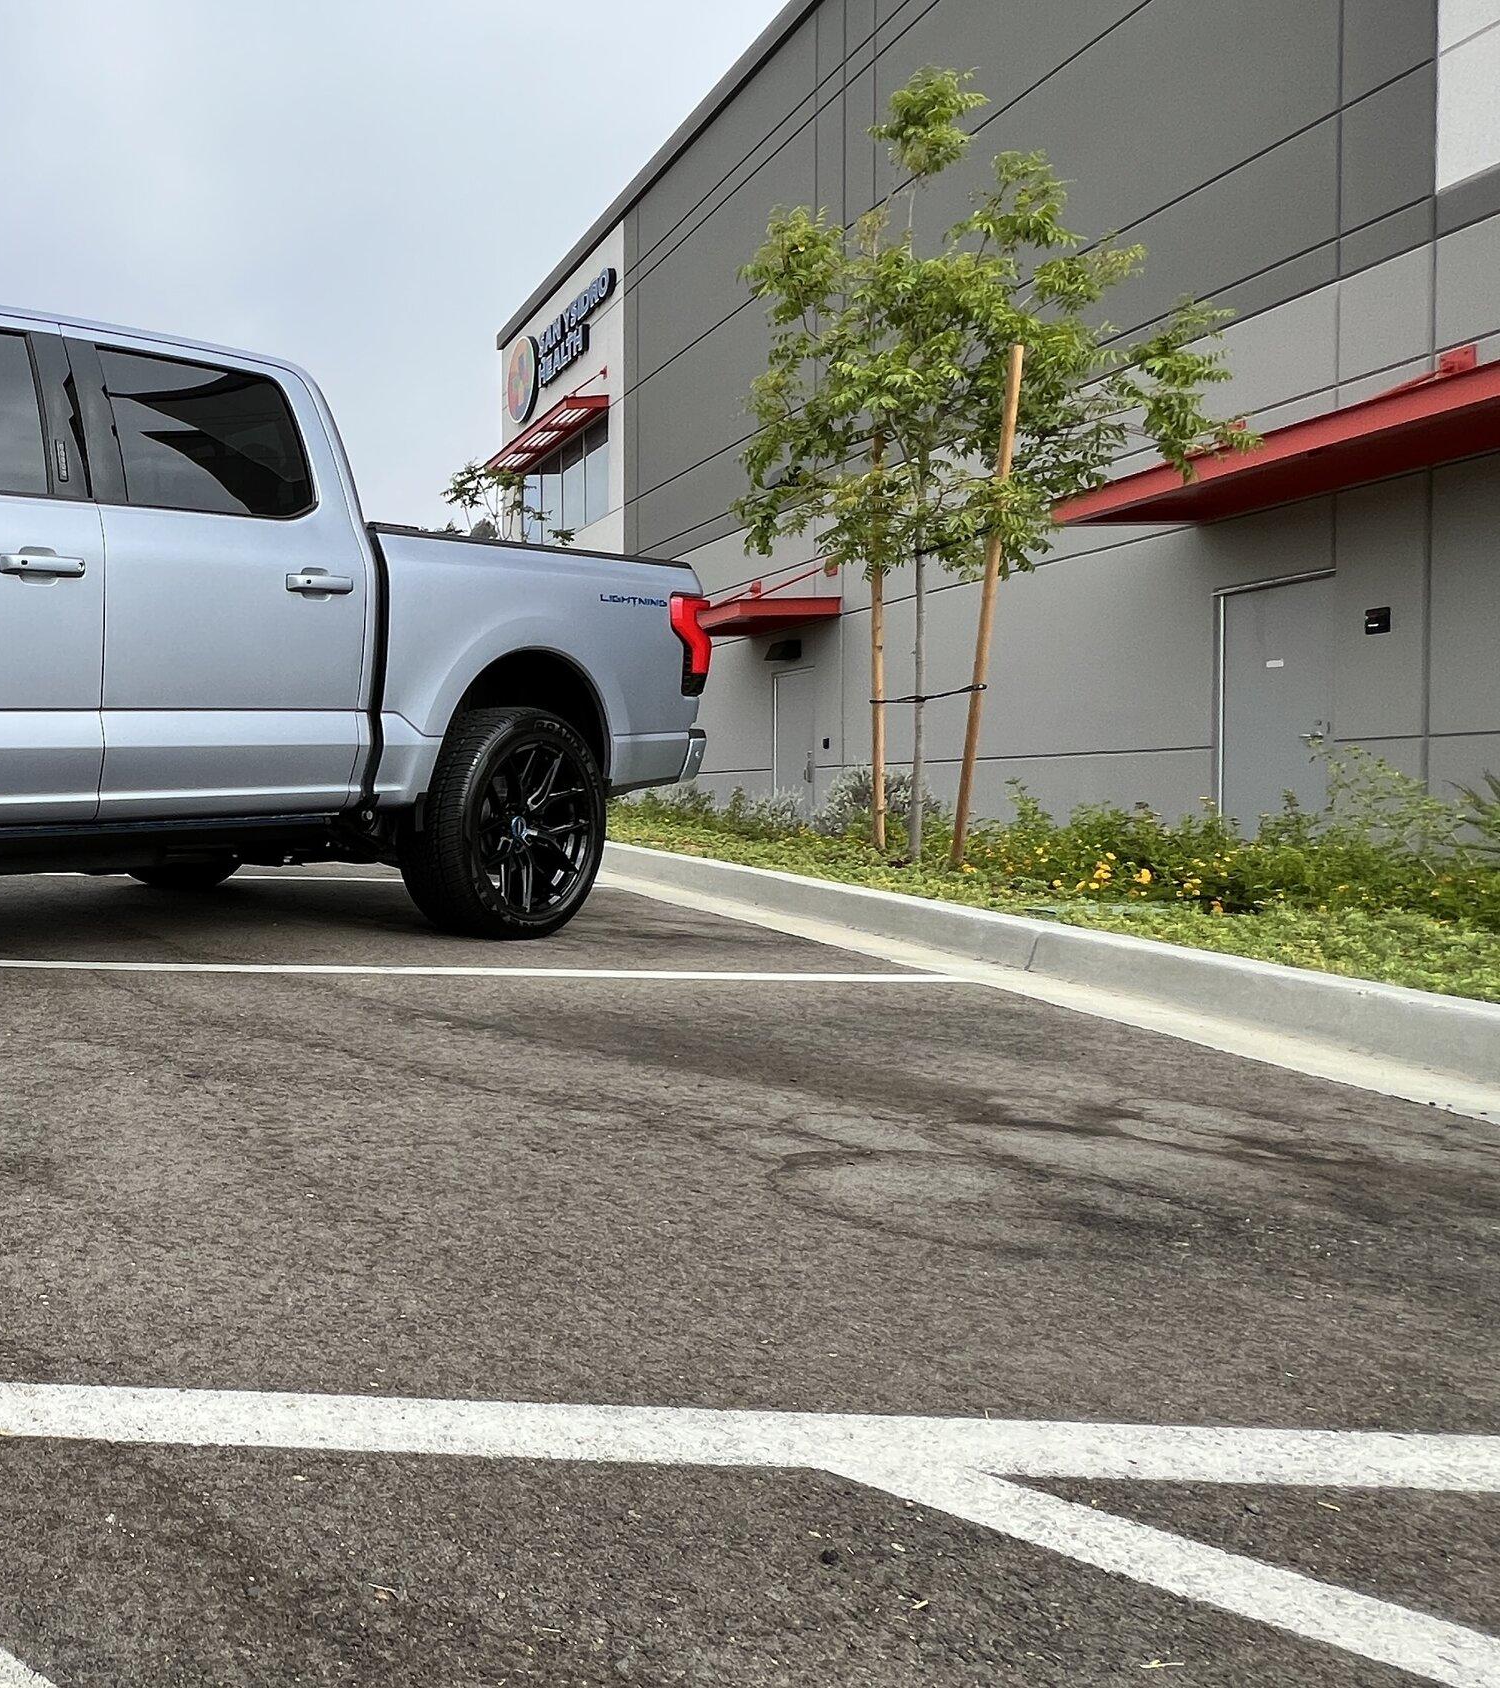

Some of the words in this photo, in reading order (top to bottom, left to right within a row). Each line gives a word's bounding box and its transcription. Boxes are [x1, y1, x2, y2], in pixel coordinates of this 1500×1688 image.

[538, 314, 562, 358] SAN
[538, 324, 587, 388] HEALTH
[600, 594, 668, 608] LIGHTNING
